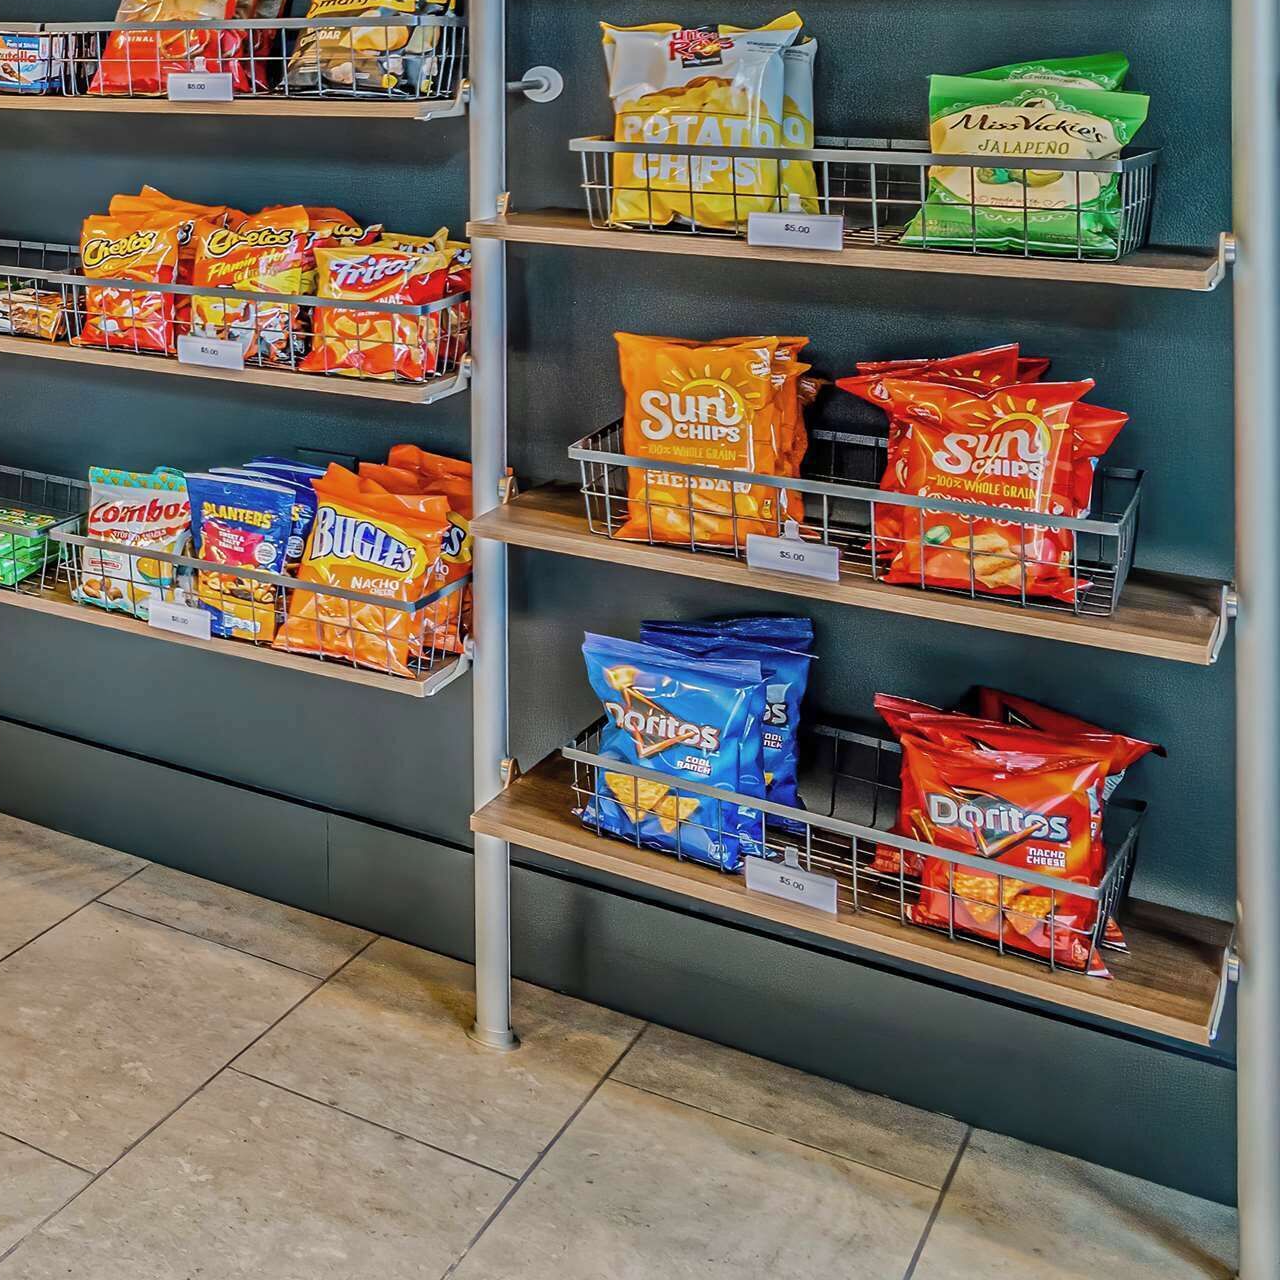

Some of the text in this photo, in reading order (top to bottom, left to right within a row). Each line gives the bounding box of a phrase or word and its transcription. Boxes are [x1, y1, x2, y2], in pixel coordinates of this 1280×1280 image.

[623, 114, 776, 148] POTATO
[948, 113, 1020, 131] Miss
[978, 138, 1070, 155] JALAPEÑO
[632, 152, 757, 187] CHIPS
[784, 223, 810, 234] $5.00
[640, 389, 744, 441] Sun
[673, 422, 741, 443] CHIPS
[673, 445, 704, 459] WHOLE
[705, 448, 737, 461] GRAIN
[931, 428, 1050, 475] Sun
[970, 457, 1046, 481] CHIPS
[935, 474, 1039, 501] 100% WHOLE GRAIN
[89, 497, 191, 523] Combos
[203, 502, 273, 529] PLANTERS
[309, 507, 416, 573] BUGLES
[779, 550, 805, 562] $5.00
[350, 576, 400, 592] NACHO
[605, 701, 721, 753] Doritos
[764, 732, 783, 743] OOL
[685, 755, 711, 768] COOL
[928, 793, 1070, 842] Doritos
[1026, 856, 1067, 868] CHEESE
[1028, 847, 1066, 860] NACHO
[779, 876, 805, 892] $5.00
